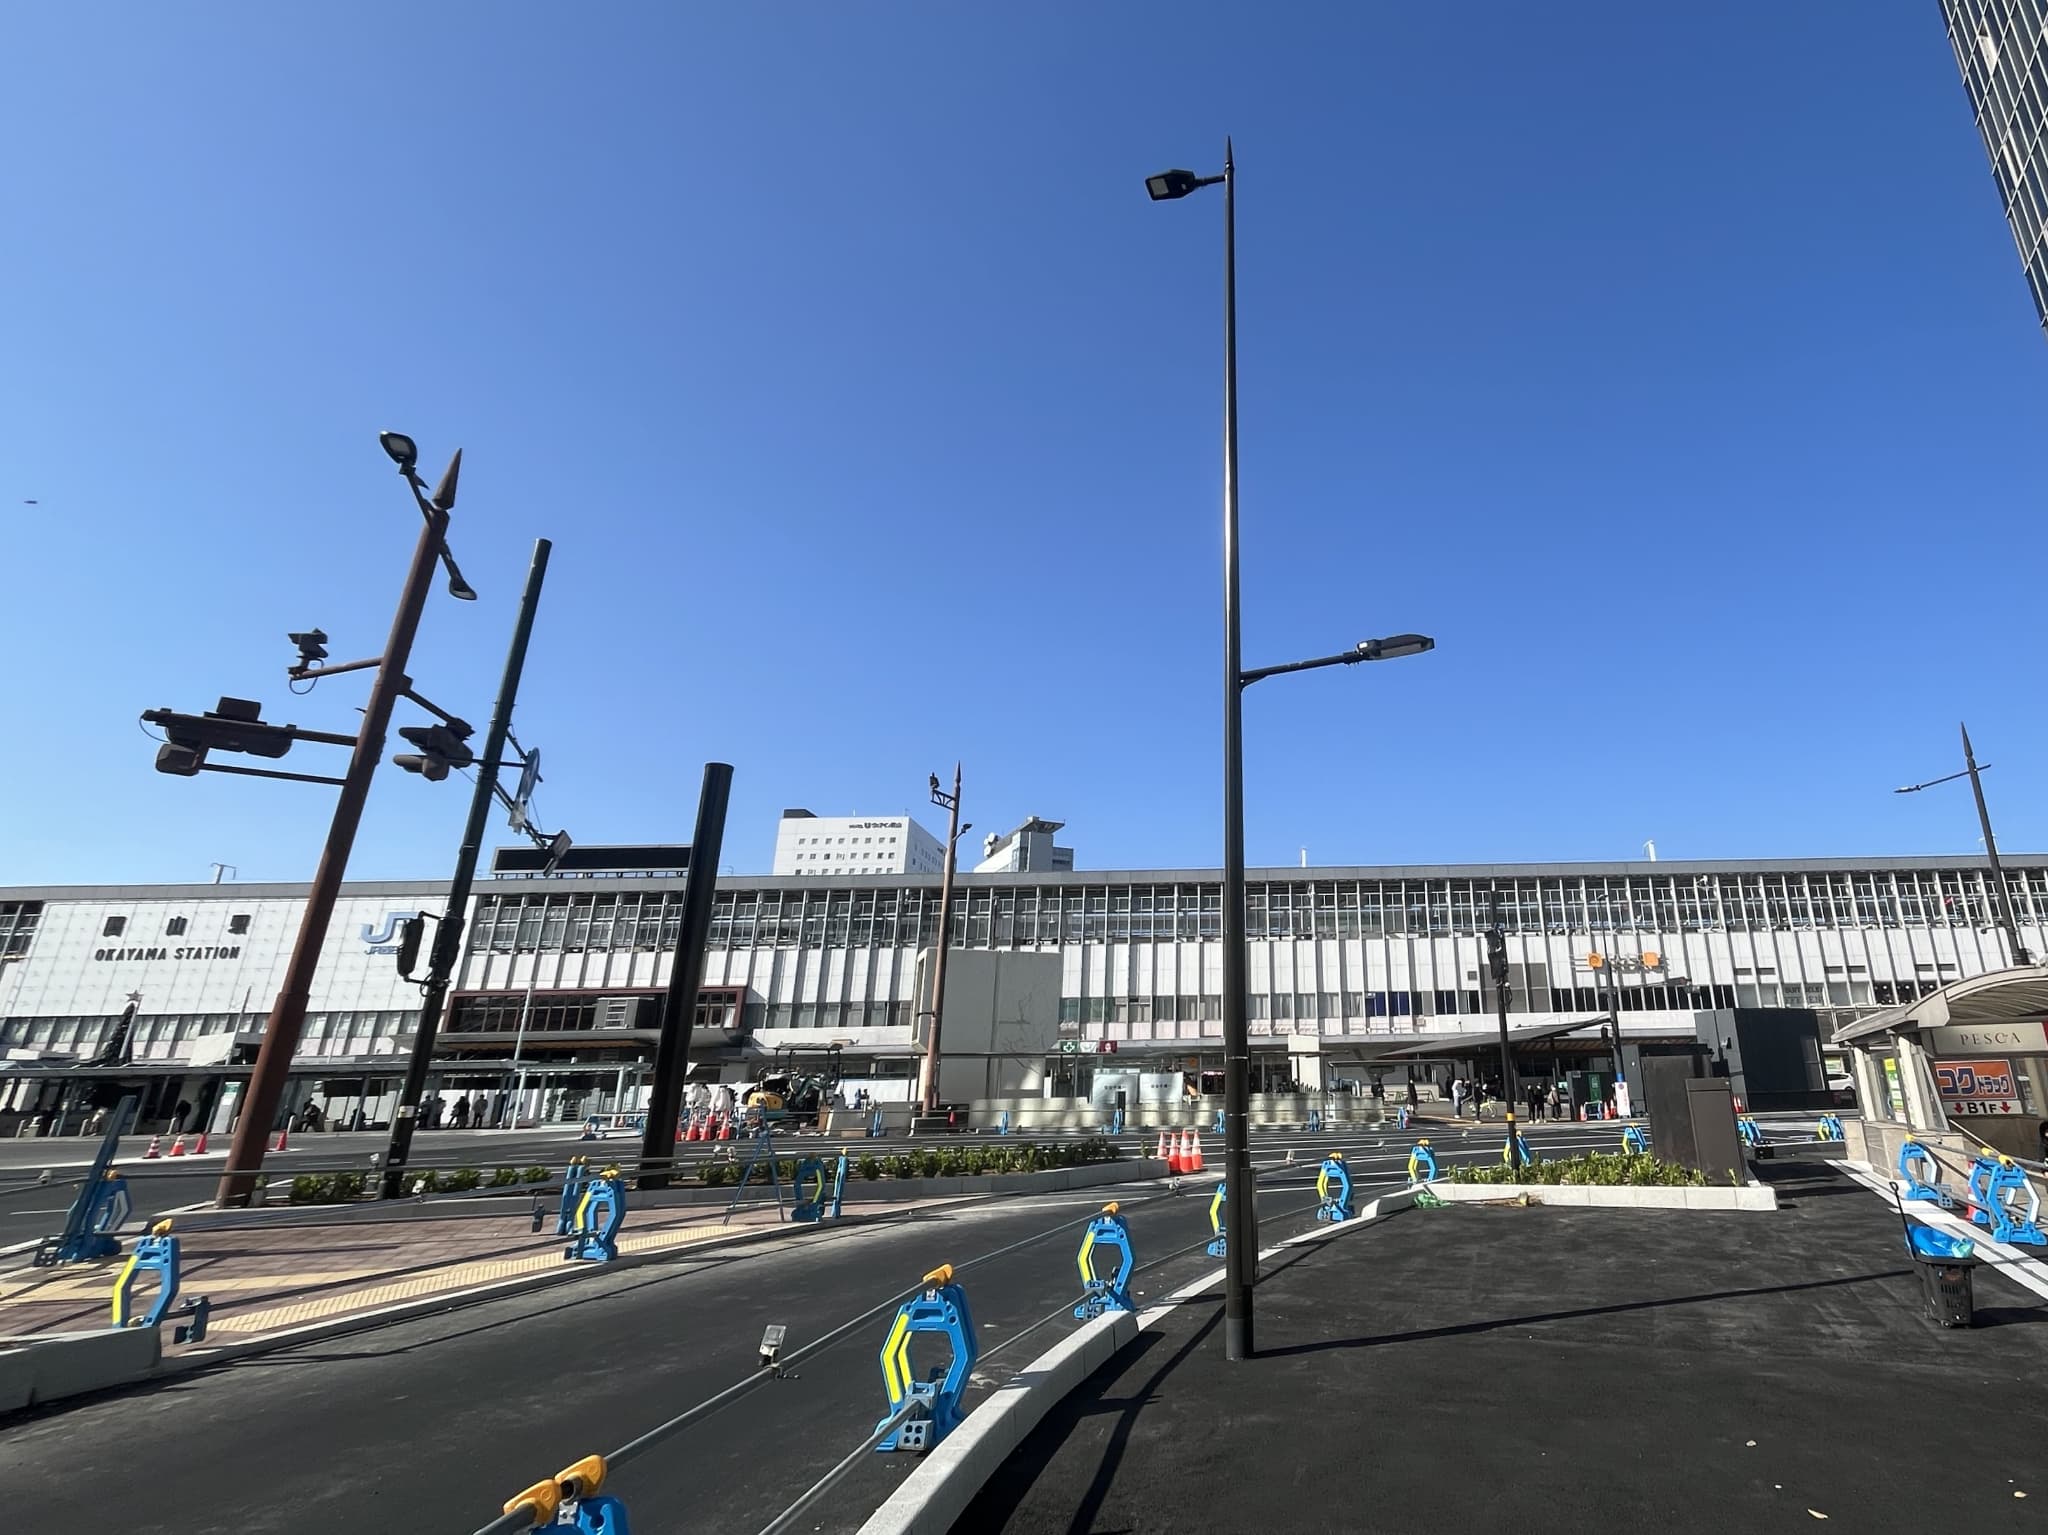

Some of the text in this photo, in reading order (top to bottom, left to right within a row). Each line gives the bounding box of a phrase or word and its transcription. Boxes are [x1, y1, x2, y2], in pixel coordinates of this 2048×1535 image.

[95, 946, 241, 961] OKAYAMA STATION
[1960, 1032, 2021, 1045] PESCA
[1967, 1102, 1998, 1114] B1F
